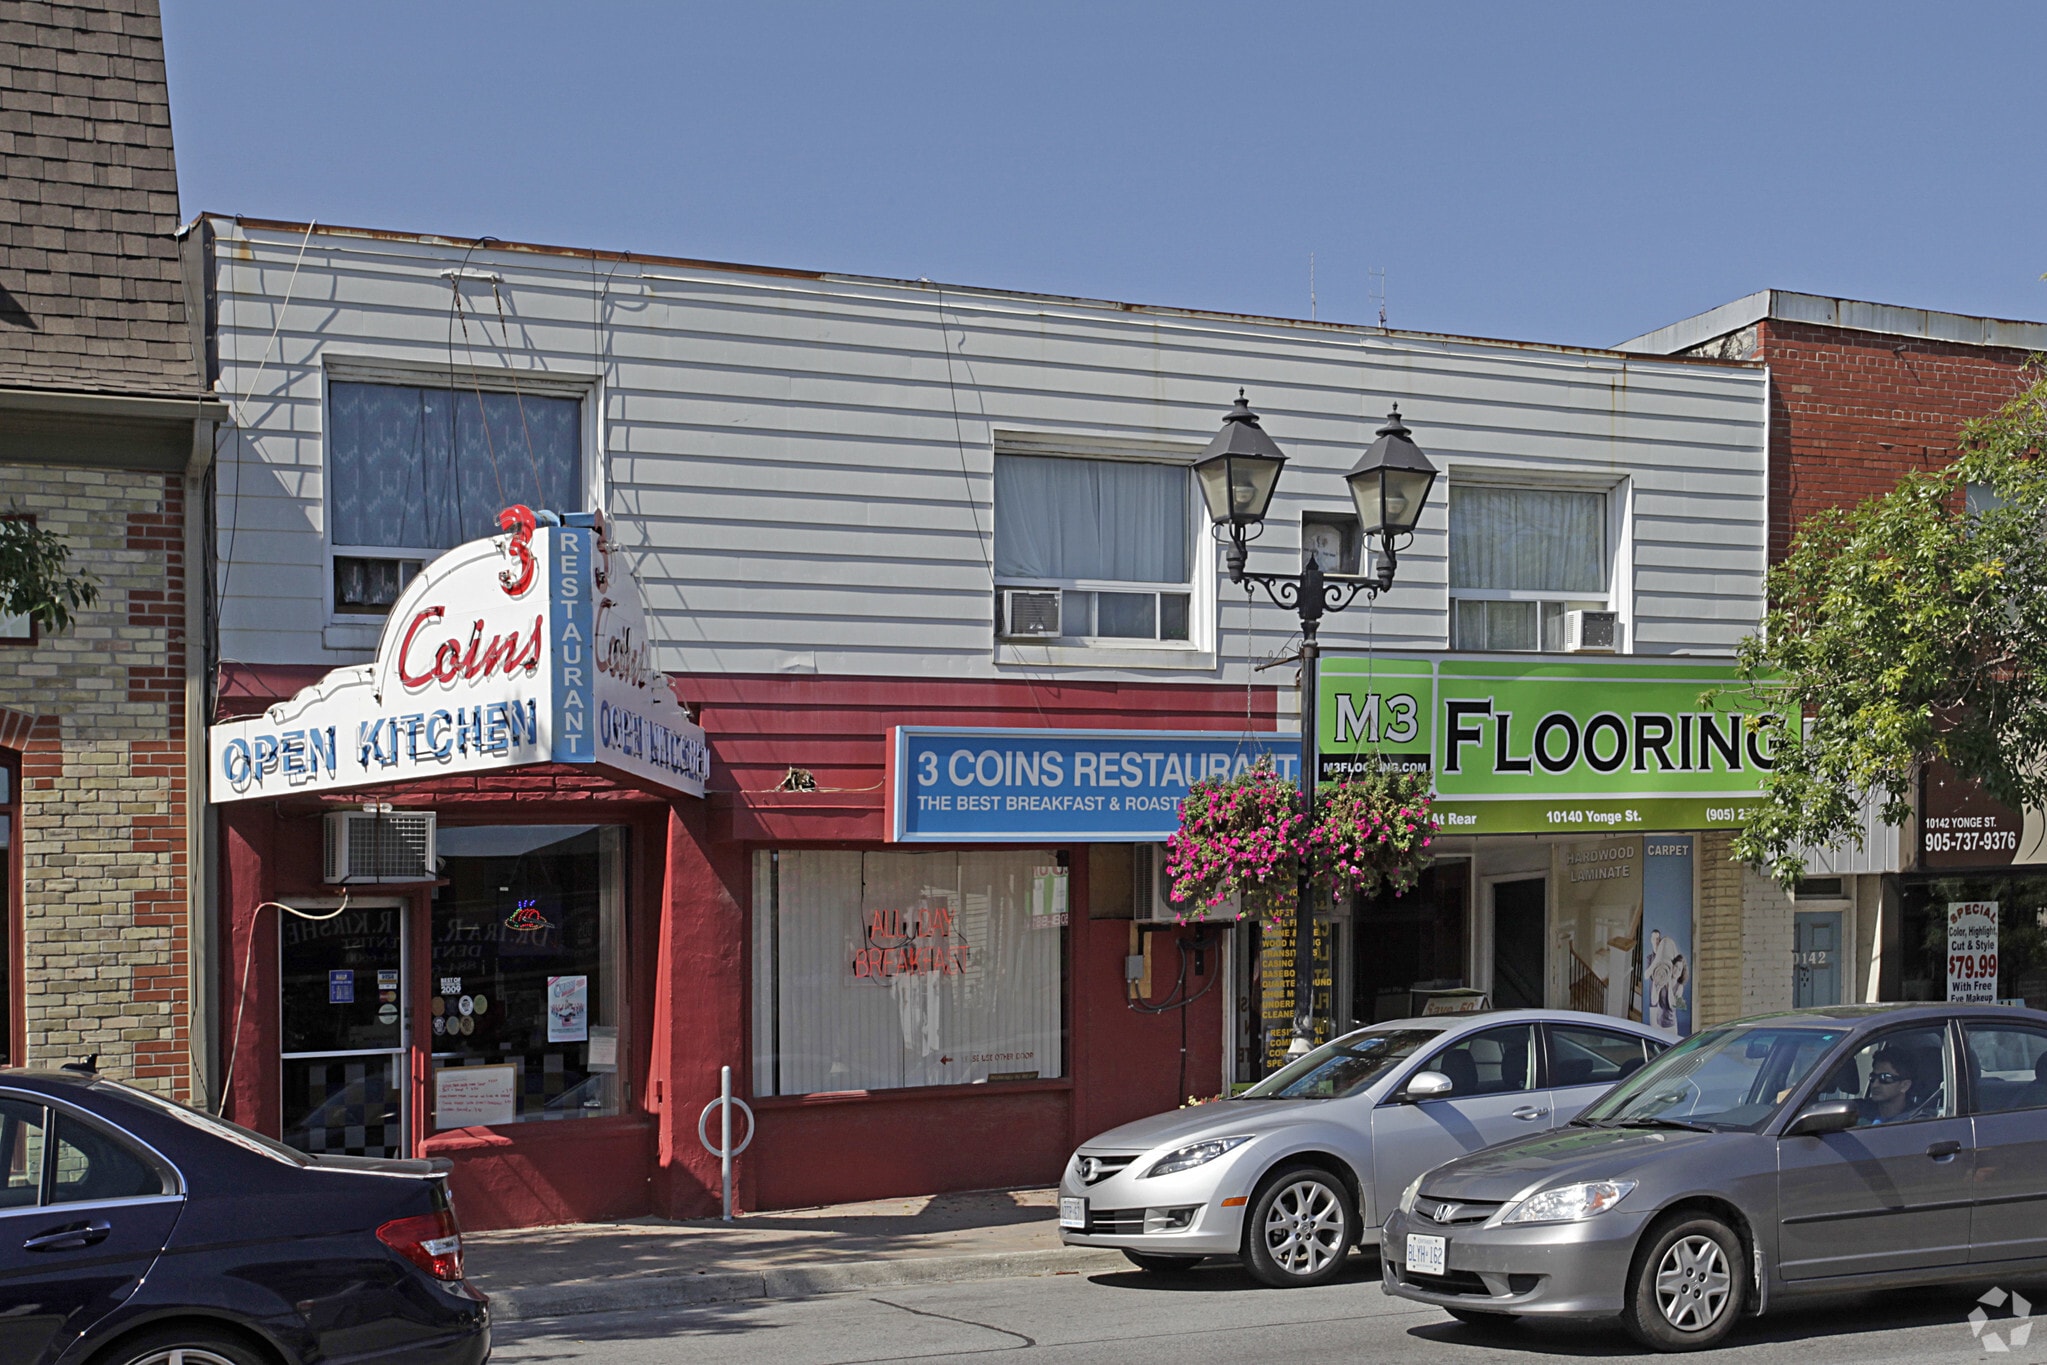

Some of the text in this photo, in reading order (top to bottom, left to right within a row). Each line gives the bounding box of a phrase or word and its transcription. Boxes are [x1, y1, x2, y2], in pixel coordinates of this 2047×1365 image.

[497, 504, 537, 596] 3
[399, 606, 543, 688] Coins
[560, 532, 585, 755] RESTAURANT
[1334, 693, 1418, 743] M3
[223, 698, 537, 784] OPEN KITCHEN
[1443, 697, 1788, 776] FLOORING
[918, 750, 939, 787] 3
[948, 749, 1064, 788] COINS
[918, 796, 1180, 812] THE BEST BREAKFAST & ROAST
[1431, 813, 1446, 825] At
[1448, 813, 1477, 825] Rear
[1547, 810, 1642, 825] 10140 Yonge St.
[1706, 807, 1735, 822] (905)
[1925, 817, 1997, 829] 10142 YONGE ST.
[1925, 831, 2016, 852] 905-737-9376
[1566, 846, 1635, 866] HARDWOOD
[1648, 845, 1689, 856] CARPET
[1570, 865, 1630, 883] LAMINATE
[1950, 904, 1996, 924] SPECIAL
[870, 908, 956, 940] ALL DAY
[1262, 939, 1287, 948] WOOD
[1951, 939, 1994, 952] Cut & Style
[854, 945, 971, 979] BREAKFAST
[1262, 959, 1294, 968] CASING
[1949, 953, 1997, 979] $79.99
[1262, 969, 1296, 978] BASEBO
[1262, 979, 1295, 988] QUARTE
[1952, 981, 1992, 992] With Free
[1262, 989, 1285, 998] SHOE
[1966, 994, 1993, 1004] Makeup
